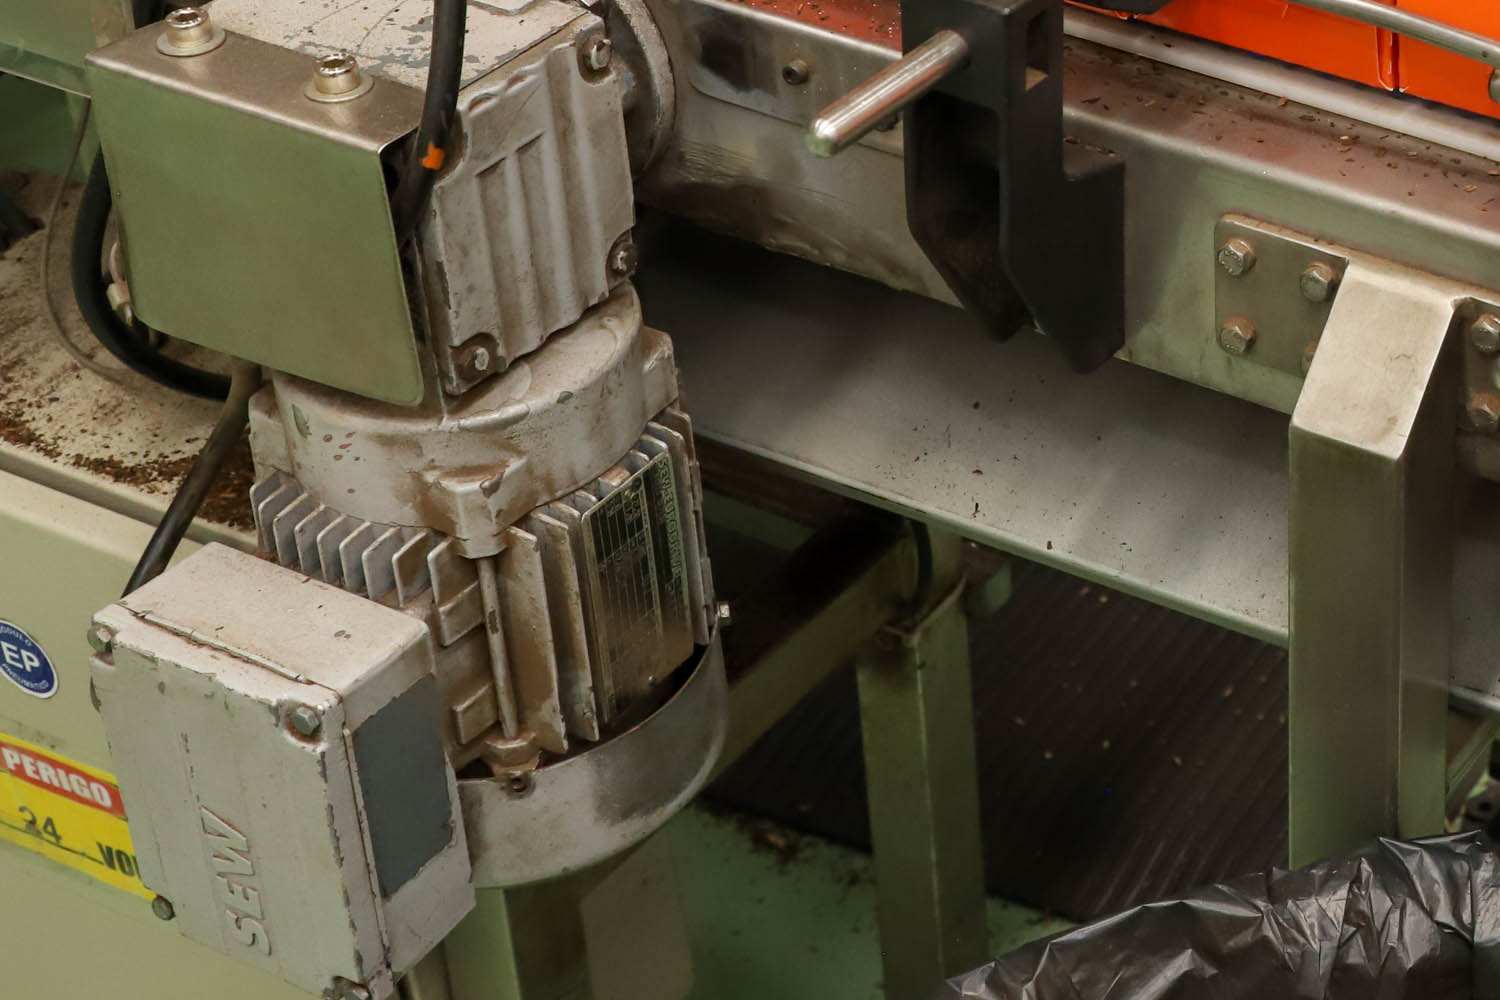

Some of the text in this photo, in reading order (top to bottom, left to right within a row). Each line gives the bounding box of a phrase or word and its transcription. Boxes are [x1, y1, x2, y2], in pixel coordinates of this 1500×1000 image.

[0, 640, 40, 673] EP
[4, 747, 113, 808] PERIGO
[200, 804, 273, 957] SEW
